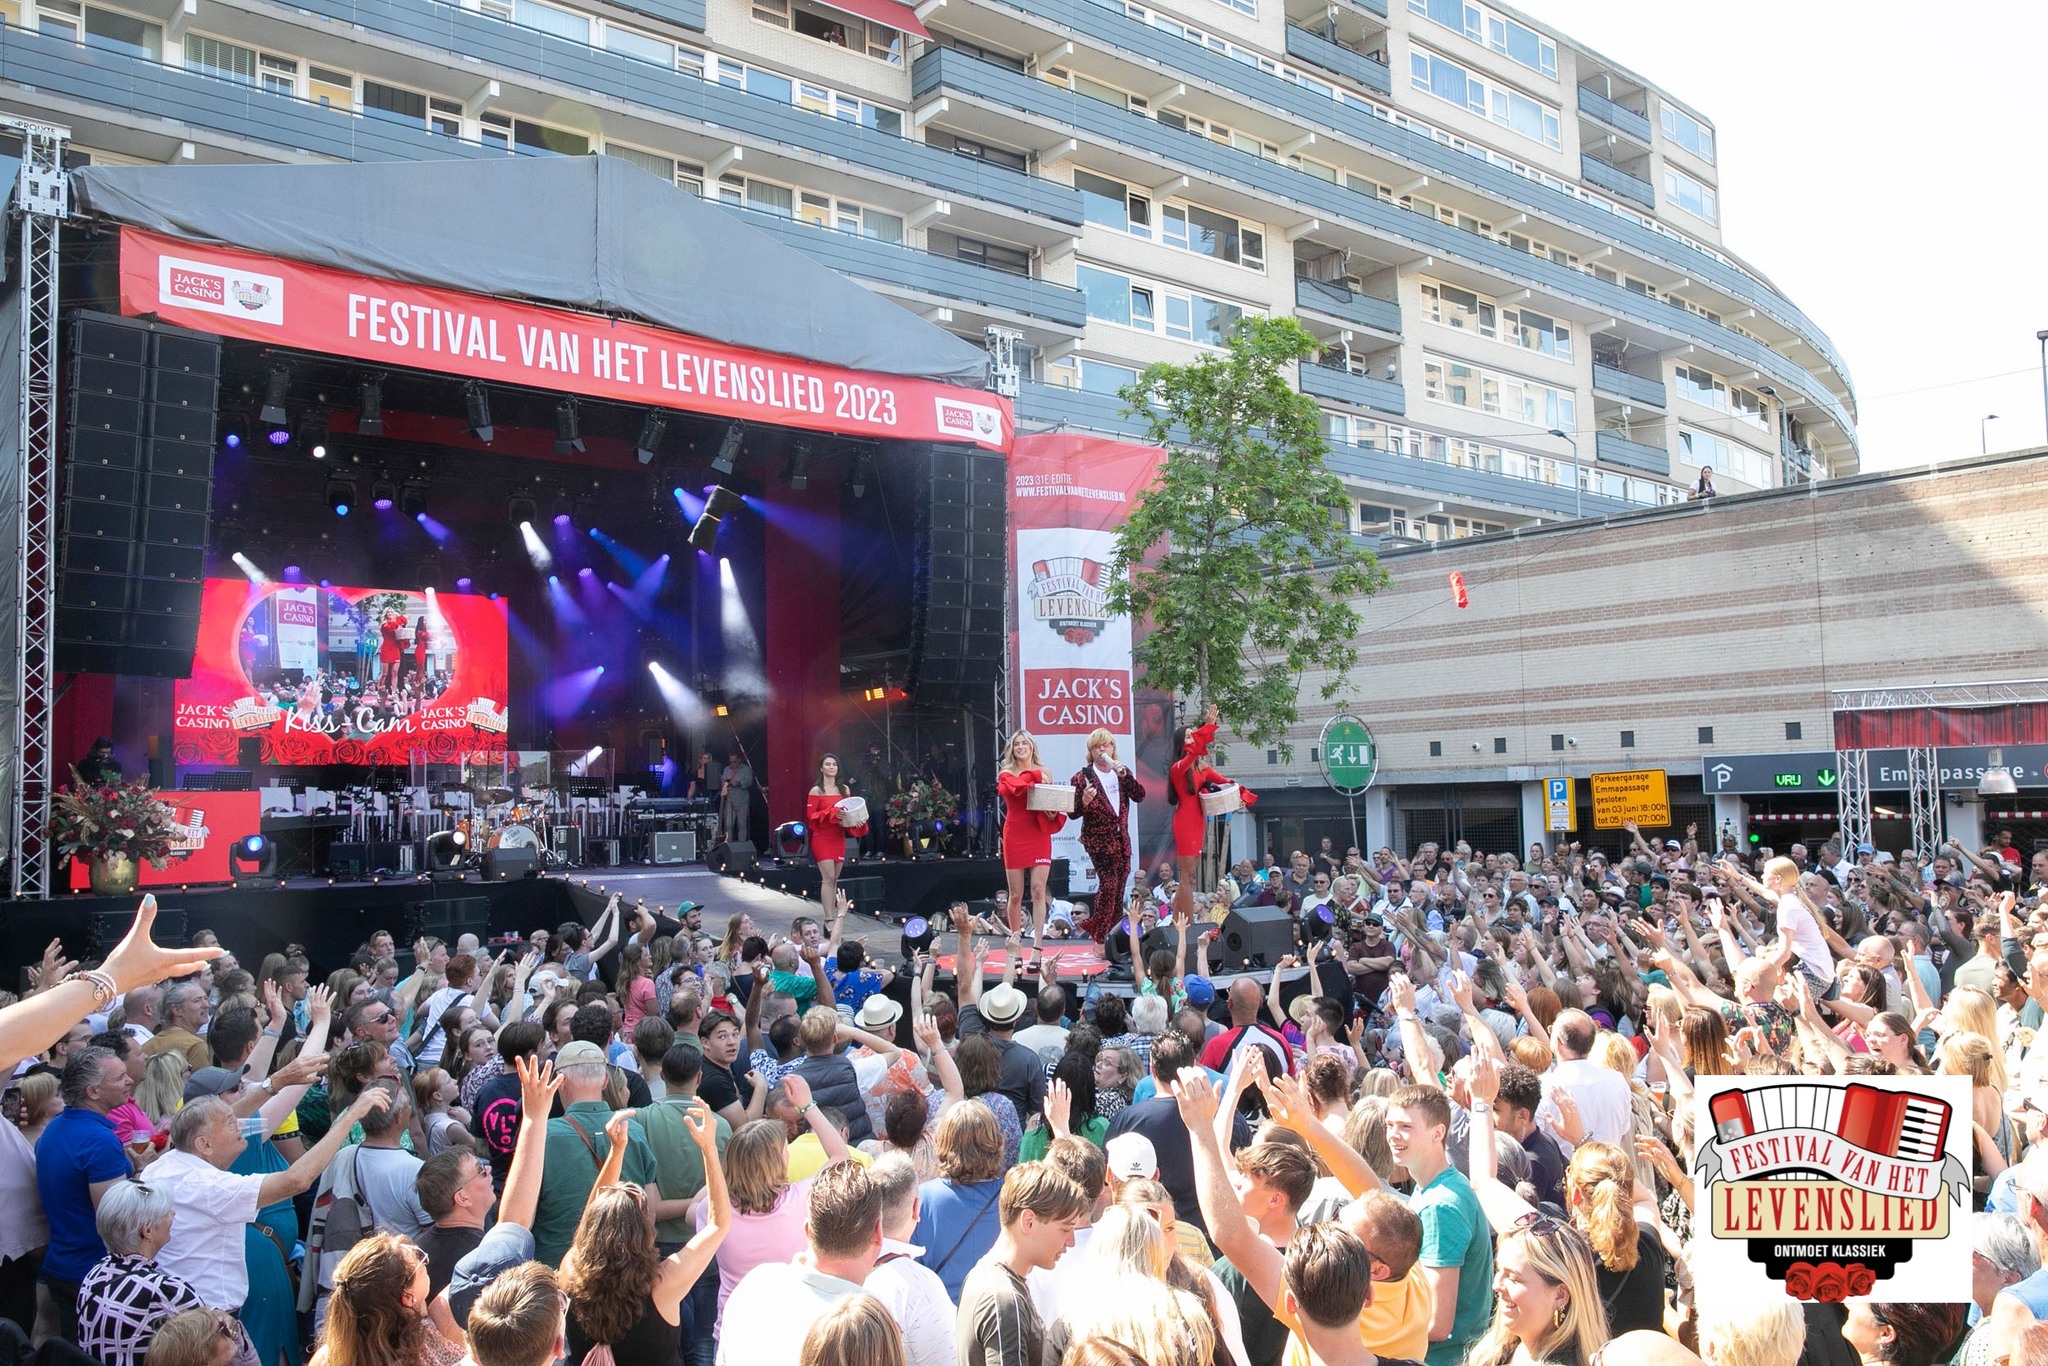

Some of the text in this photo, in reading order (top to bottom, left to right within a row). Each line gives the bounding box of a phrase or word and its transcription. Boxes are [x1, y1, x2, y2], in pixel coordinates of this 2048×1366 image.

[174, 273, 221, 290] JACK'S
[174, 283, 221, 300] CASINO
[349, 293, 897, 426] FESTIVAL VAN HET LEVENSLIED 2023
[944, 409, 972, 420] JACK'S
[945, 416, 972, 427] CASINO
[1015, 473, 1072, 486] 2023 31E EDITIE
[1015, 485, 1127, 502] WWW.FESTIVALVANHETLEVENSLIED.NL
[1040, 577, 1080, 594] FESTIVAL
[1081, 585, 1094, 600] VAN
[283, 602, 314, 615] JACK'S
[283, 612, 315, 624] CASINO
[1038, 677, 1122, 699] JACK'S
[176, 703, 230, 717] JACK'S
[420, 706, 466, 719] JACK'S
[1038, 704, 1124, 725] CASINO
[175, 716, 230, 729] CASINO
[421, 719, 467, 731] CASINO
[1594, 773, 1650, 784] Parkeergarage
[1776, 774, 1801, 786] VRIJ
[1553, 782, 1564, 799] P
[1595, 783, 1650, 793] Emmapassage
[1596, 796, 1628, 804] gesloten
[1612, 805, 1622, 813] 03
[1624, 804, 1639, 816] juni
[1640, 803, 1667, 812] 18:00h
[1597, 817, 1609, 825] tot
[1610, 816, 1620, 824] 05
[1638, 814, 1666, 823] 07:00h
